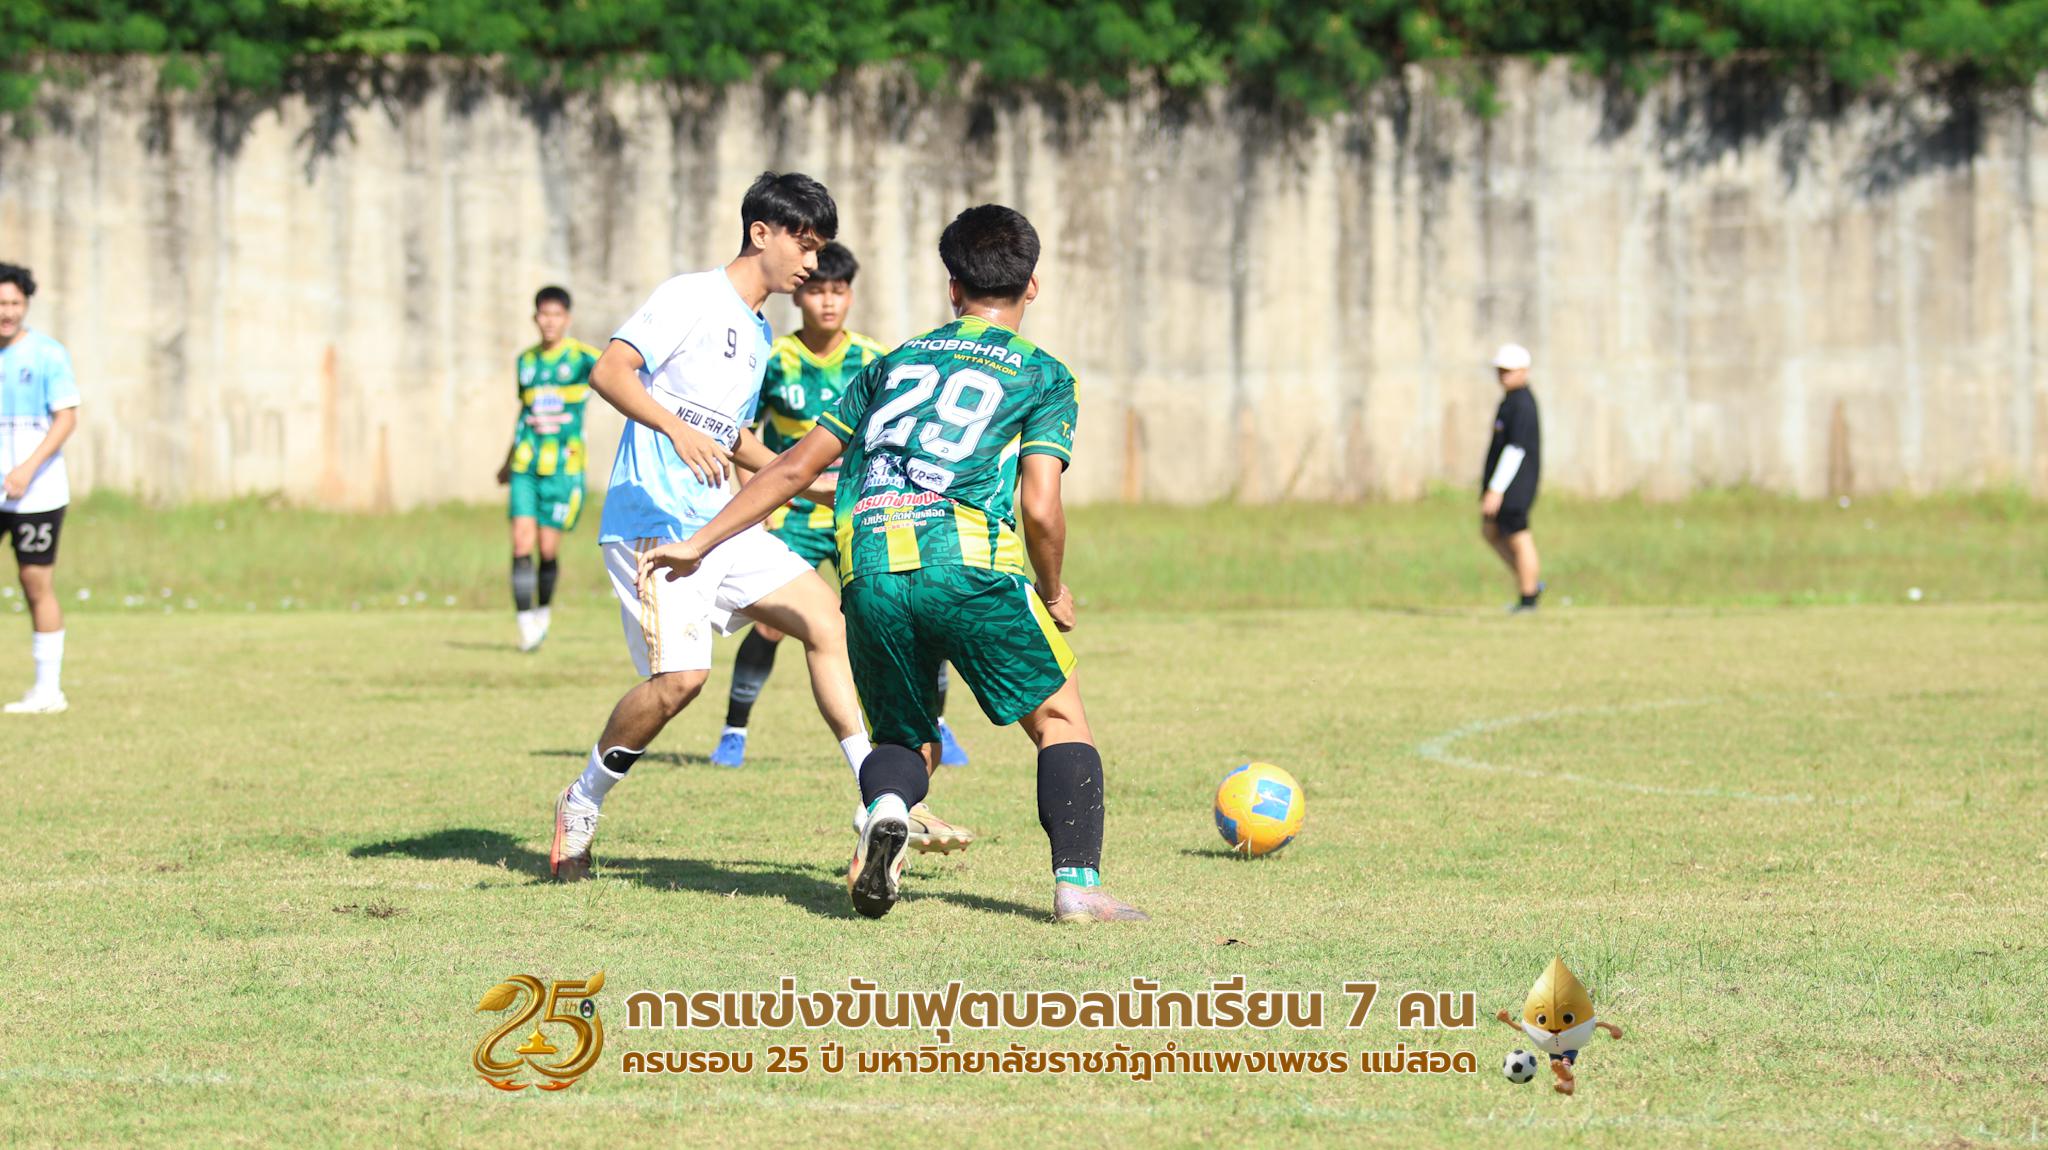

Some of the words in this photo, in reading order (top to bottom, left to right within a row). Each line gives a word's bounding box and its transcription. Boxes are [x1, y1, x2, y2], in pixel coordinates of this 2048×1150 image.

[723, 327, 737, 359] 9
[904, 338, 1022, 368] PHOBPHRA
[953, 353, 1018, 377] WITTAYAKOM
[676, 405, 704, 426] NEW
[864, 363, 1005, 463] 29
[18, 522, 53, 553] 25
